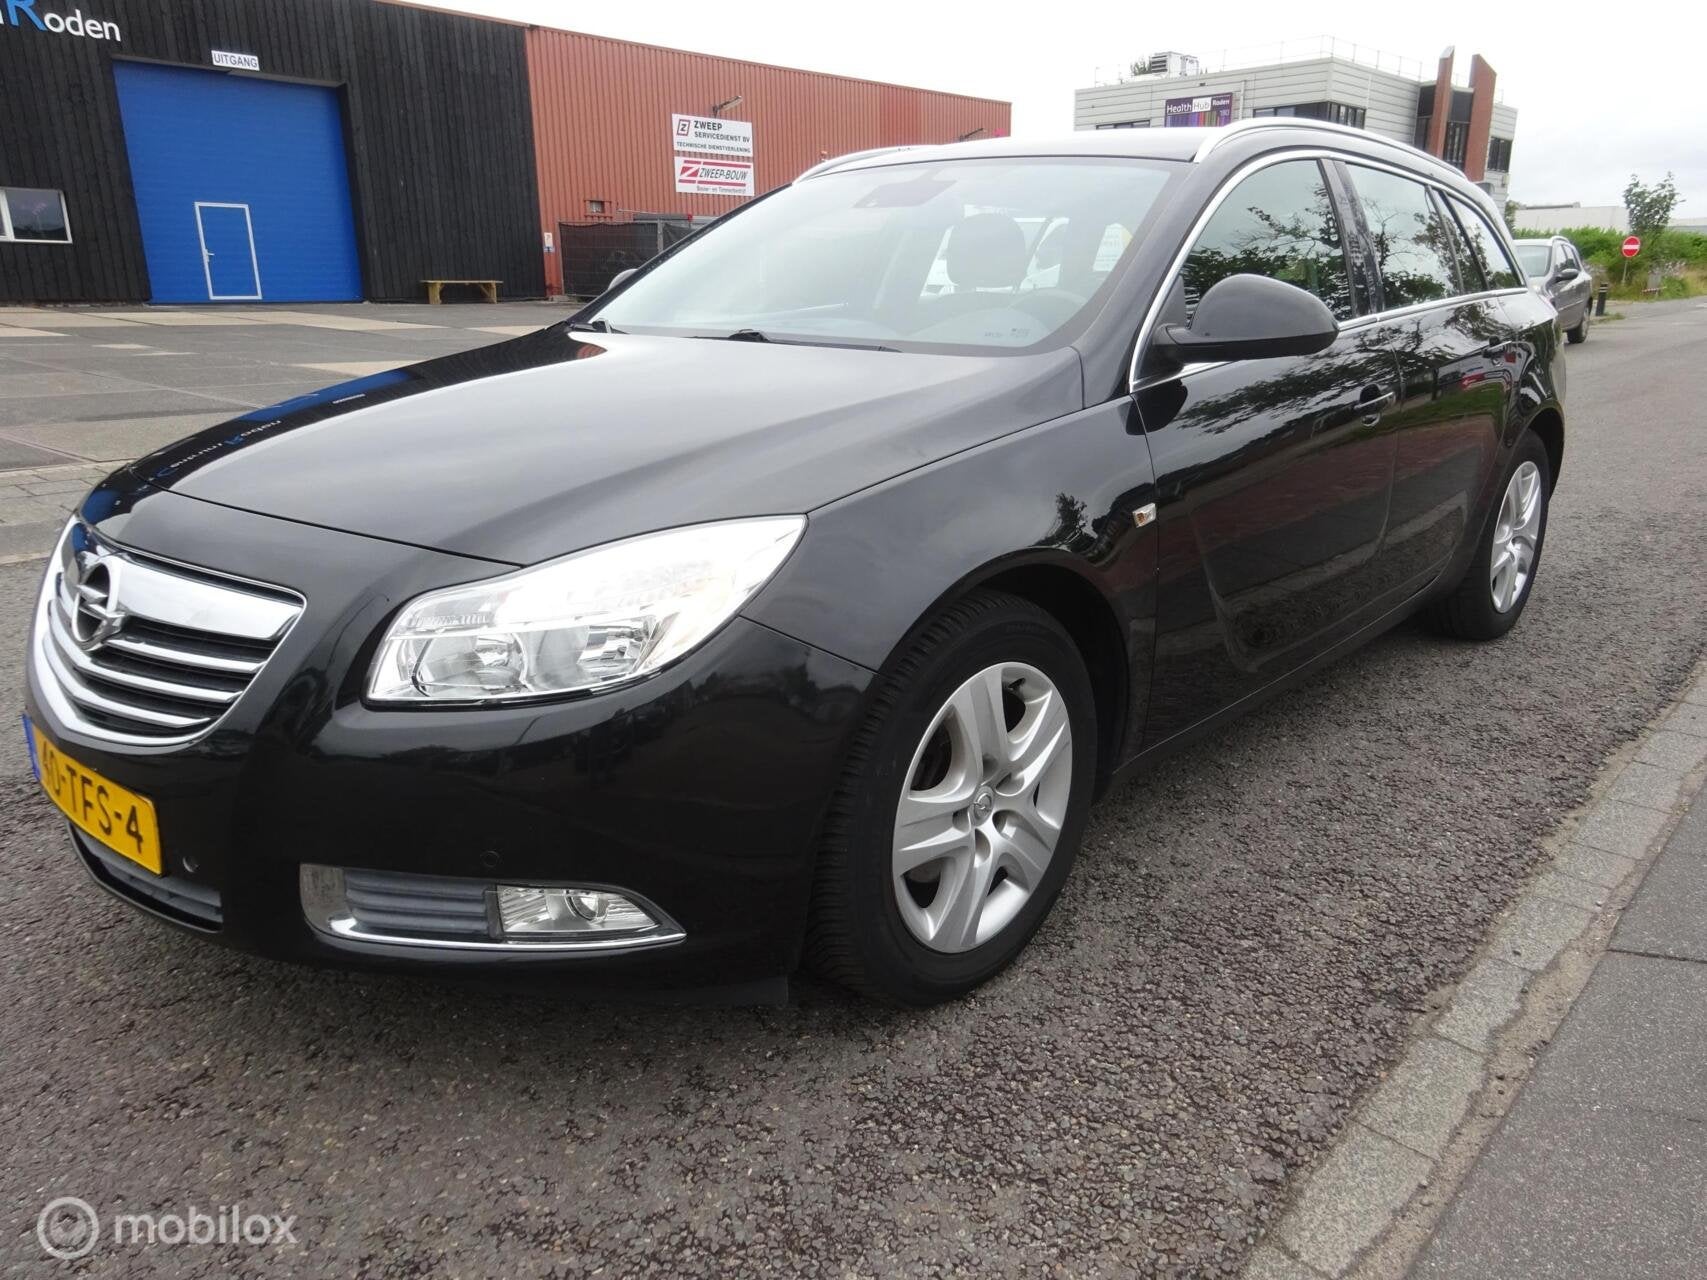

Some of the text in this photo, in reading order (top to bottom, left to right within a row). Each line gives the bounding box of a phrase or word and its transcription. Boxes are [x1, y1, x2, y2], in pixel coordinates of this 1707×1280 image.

[213, 52, 259, 69] UITGANG
[1166, 103, 1192, 113] Health
[1194, 101, 1210, 110] Hub
[694, 120, 723, 131] ZWEEP
[694, 131, 741, 142] SERVICEDIENST
[676, 141, 751, 153] TECHNISCHE DIENSTVERLENING
[699, 167, 748, 181] ZWEEP-BOUW
